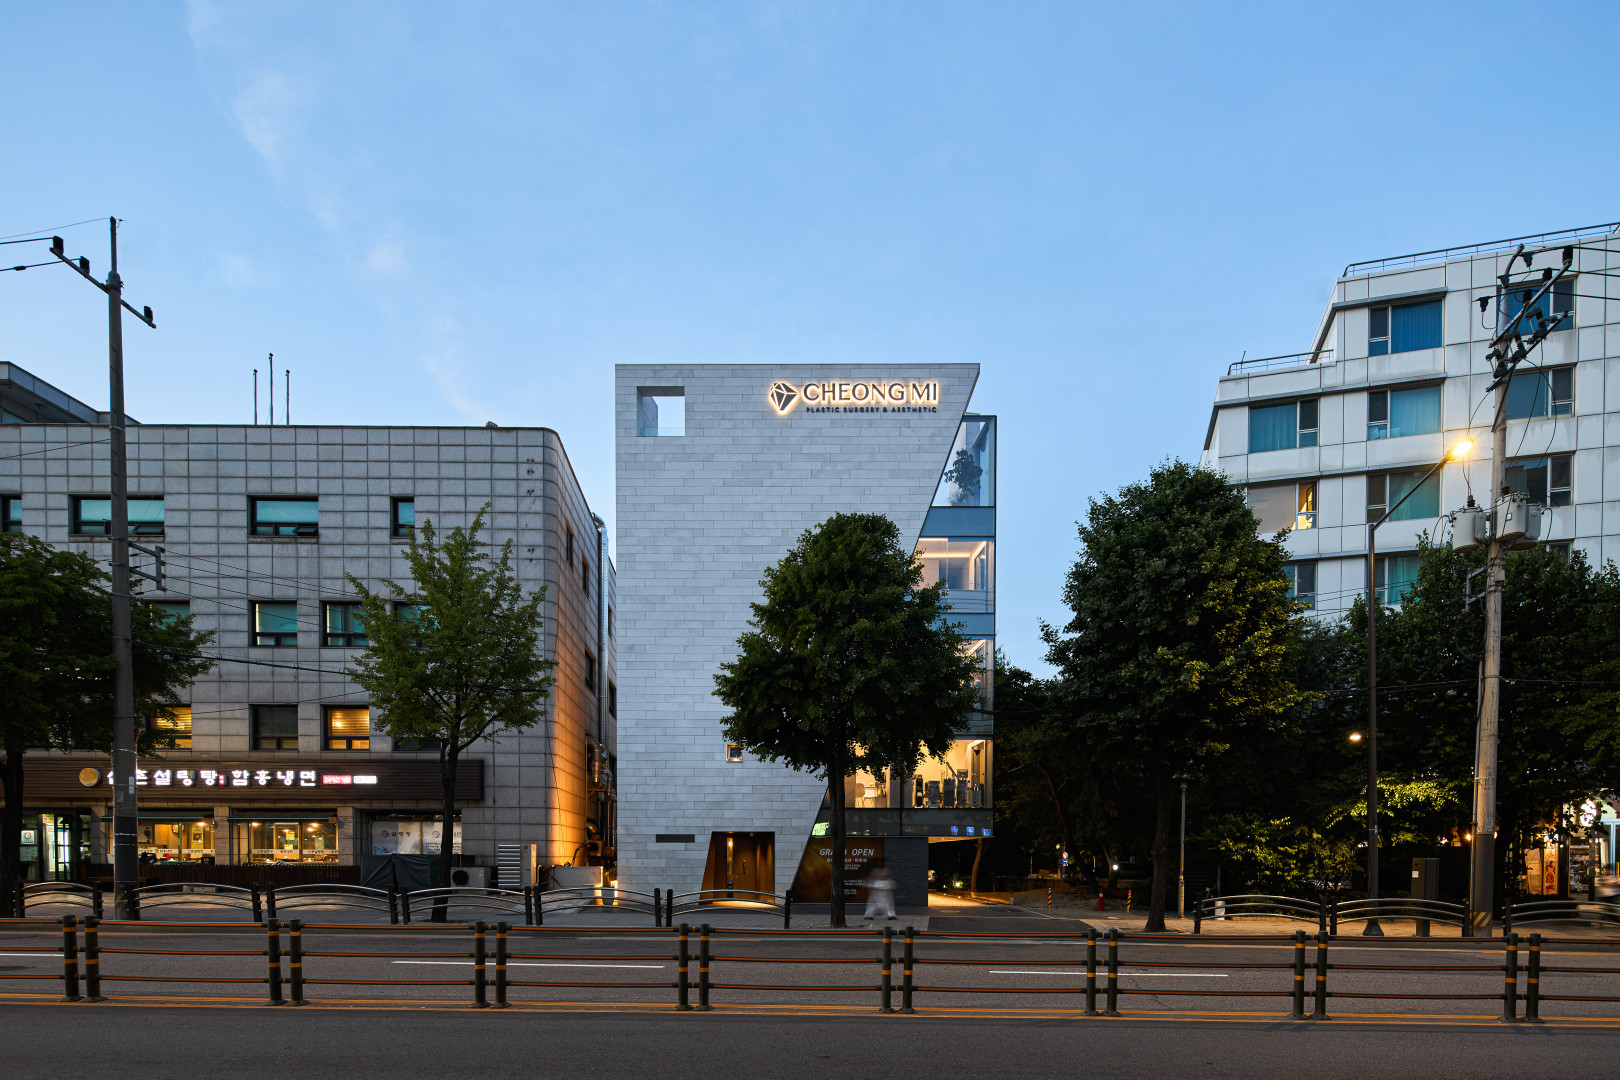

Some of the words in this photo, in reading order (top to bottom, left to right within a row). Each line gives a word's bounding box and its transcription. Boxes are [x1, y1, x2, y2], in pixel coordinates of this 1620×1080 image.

[803, 383, 905, 401] CHEONG
[912, 383, 937, 401] MI
[231, 769, 317, 787] 함흥냉면
[851, 848, 874, 856] OPEN
